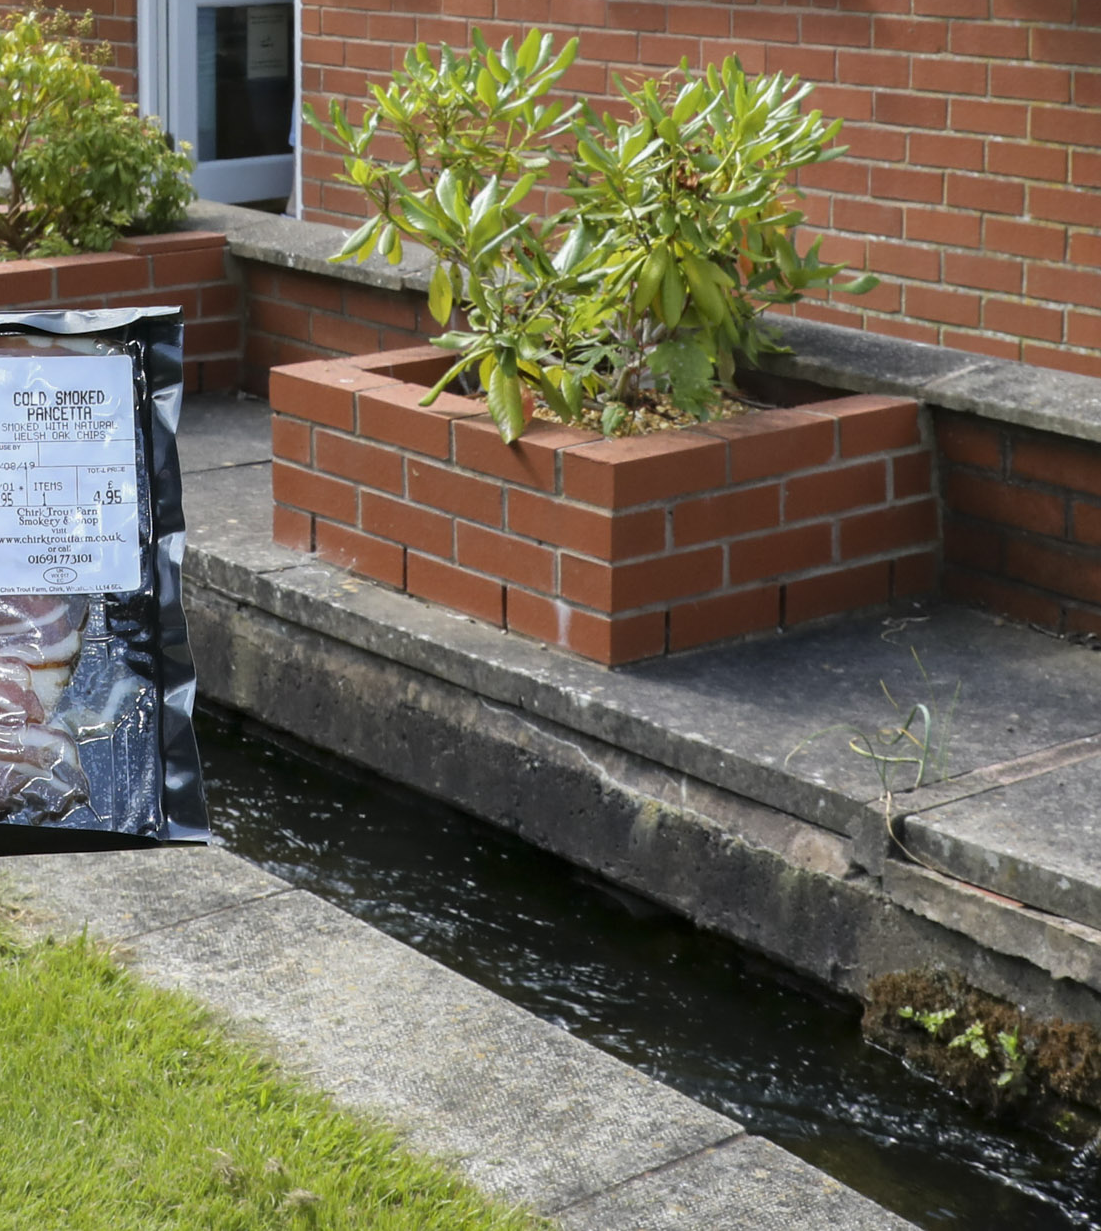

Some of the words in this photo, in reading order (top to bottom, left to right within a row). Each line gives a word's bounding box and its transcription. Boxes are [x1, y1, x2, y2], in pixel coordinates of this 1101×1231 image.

[13, 391, 47, 407] COLD
[55, 390, 105, 406] SMOKED
[27, 406, 92, 421] PANCETTA
[1, 422, 39, 432] SMOKED
[45, 422, 69, 431] WITH
[14, 431, 46, 441] WELSH
[52, 431, 70, 440] OAK
[76, 430, 106, 440] CHIPS
[33, 481, 63, 492] ITEMS
[42, 492, 47, 507] 1
[93, 489, 123, 505] 4.95
[18, 516, 61, 527] Smokery
